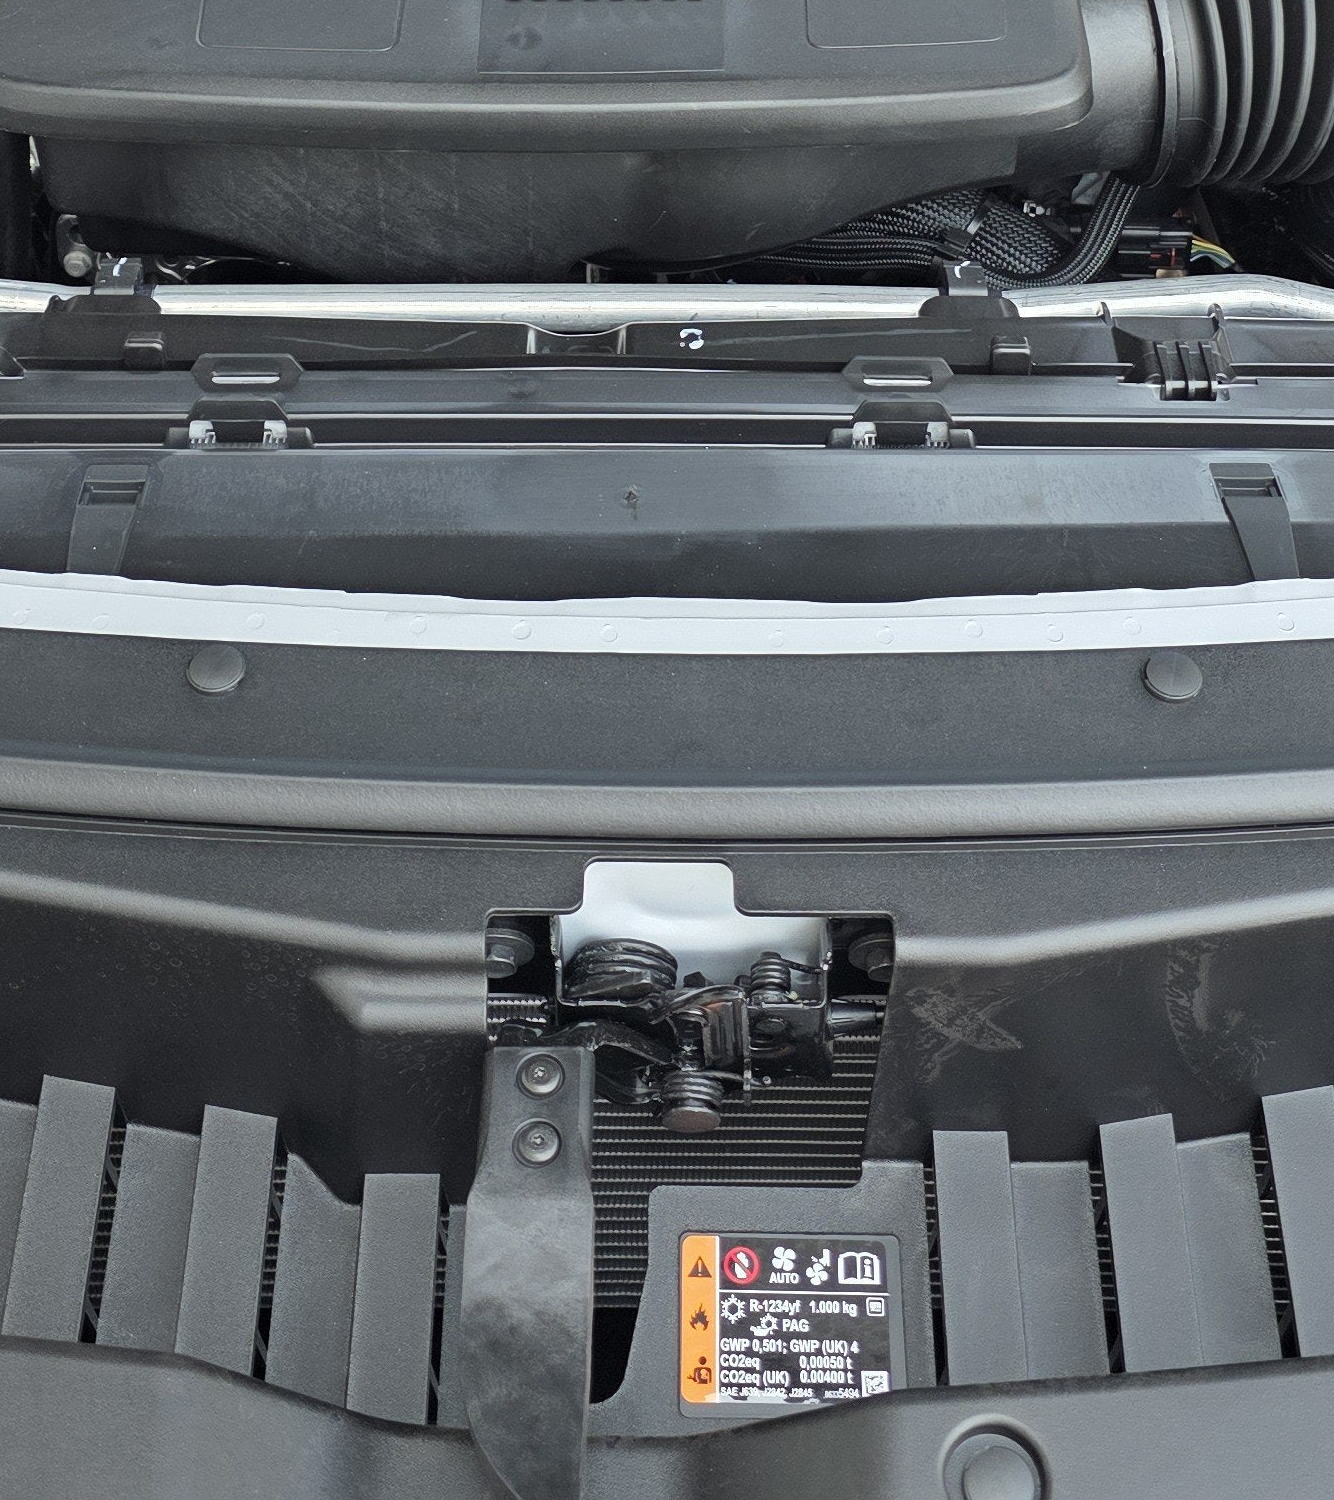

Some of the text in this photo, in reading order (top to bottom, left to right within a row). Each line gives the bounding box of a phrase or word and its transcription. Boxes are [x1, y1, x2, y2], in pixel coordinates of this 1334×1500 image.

[769, 1272, 799, 1284] AUTO
[749, 1299, 801, 1316] R-1234yf
[809, 1300, 840, 1314] 1.000
[842, 1300, 858, 1317] kg
[782, 1319, 810, 1333] PAG
[719, 1338, 859, 1356] GWP 0,501; GWP (UK) 4
[719, 1354, 854, 1370] CO2eq 0,00050 t
[719, 1370, 854, 1387] CO2eq (UK) 0.00400 t
[719, 1386, 739, 1396] SAE
